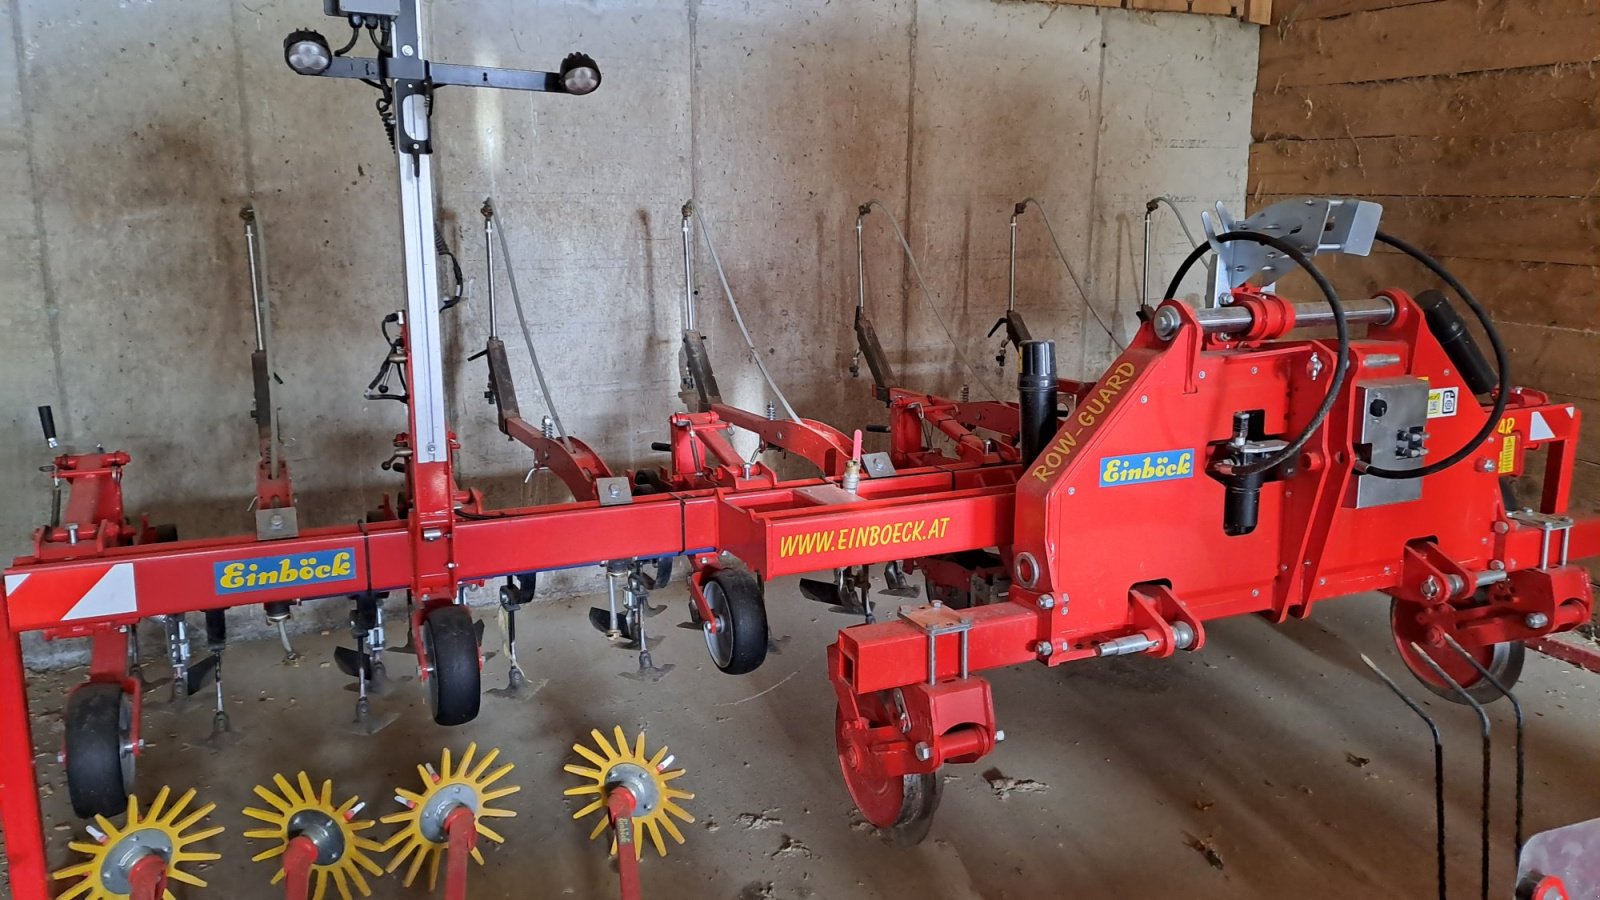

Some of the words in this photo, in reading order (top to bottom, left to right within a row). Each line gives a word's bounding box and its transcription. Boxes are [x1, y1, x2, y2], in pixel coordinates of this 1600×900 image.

[1032, 362, 1135, 482] ROW-GUARD
[1103, 453, 1191, 483] Einböck
[780, 517, 950, 557] WWW.EINBOECK.AT
[220, 552, 351, 589] Einböck
